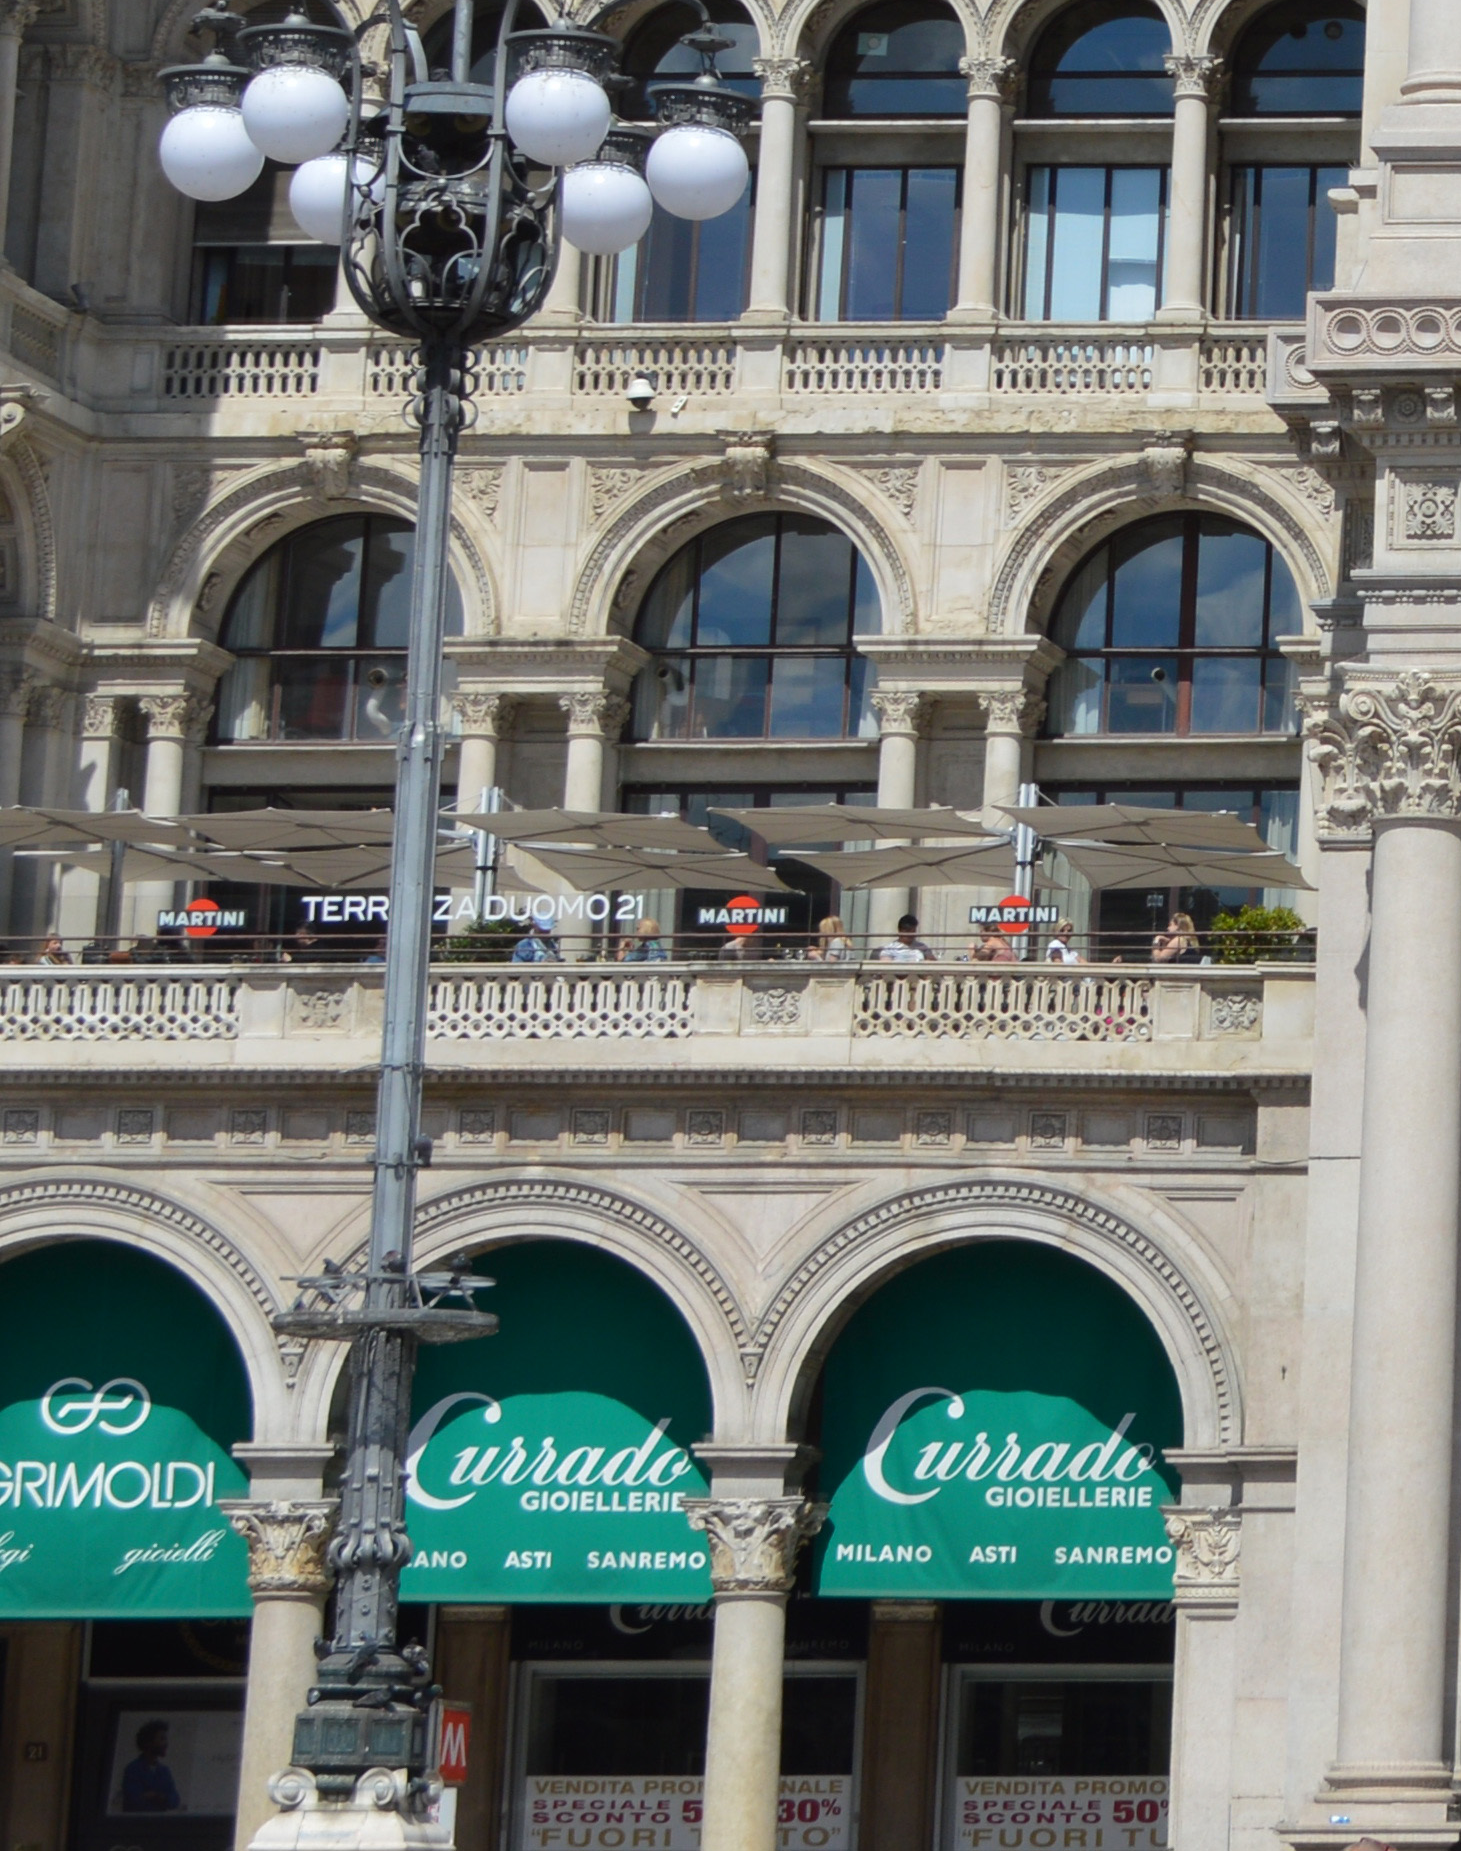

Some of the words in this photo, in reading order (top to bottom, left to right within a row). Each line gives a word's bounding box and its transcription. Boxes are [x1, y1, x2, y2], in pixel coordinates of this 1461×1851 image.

[301, 895, 477, 922] TERRZA
[485, 894, 611, 922] DUOMO
[615, 894, 644, 921] 21
[697, 908, 787, 925] MARTINI
[971, 908, 1058, 924] MARTINI
[158, 911, 246, 927] MARTINI
[405, 1391, 692, 1510] Currado
[863, 1386, 1157, 1506] Currado
[520, 1490, 687, 1512] GIOIELLERIE
[985, 1486, 1152, 1508] GIOIELLERIE
[112, 1528, 227, 1576] gioielli
[503, 1551, 552, 1570] ASTI
[586, 1551, 707, 1570] SANREMO
[836, 1544, 933, 1564] MILANO
[969, 1545, 1018, 1564] ASTI
[1054, 1545, 1174, 1565] SANREMO
[958, 1642, 1016, 1653] MILANO
[441, 1722, 467, 1767] M
[535, 1779, 635, 1795] VENDITA
[964, 1780, 1066, 1796] VENDITA
[532, 1799, 672, 1810] SPECIALE
[963, 1800, 1102, 1811] SPECIALE
[532, 1811, 671, 1824] SCONTO
[963, 1812, 1102, 1824] SCONTO
